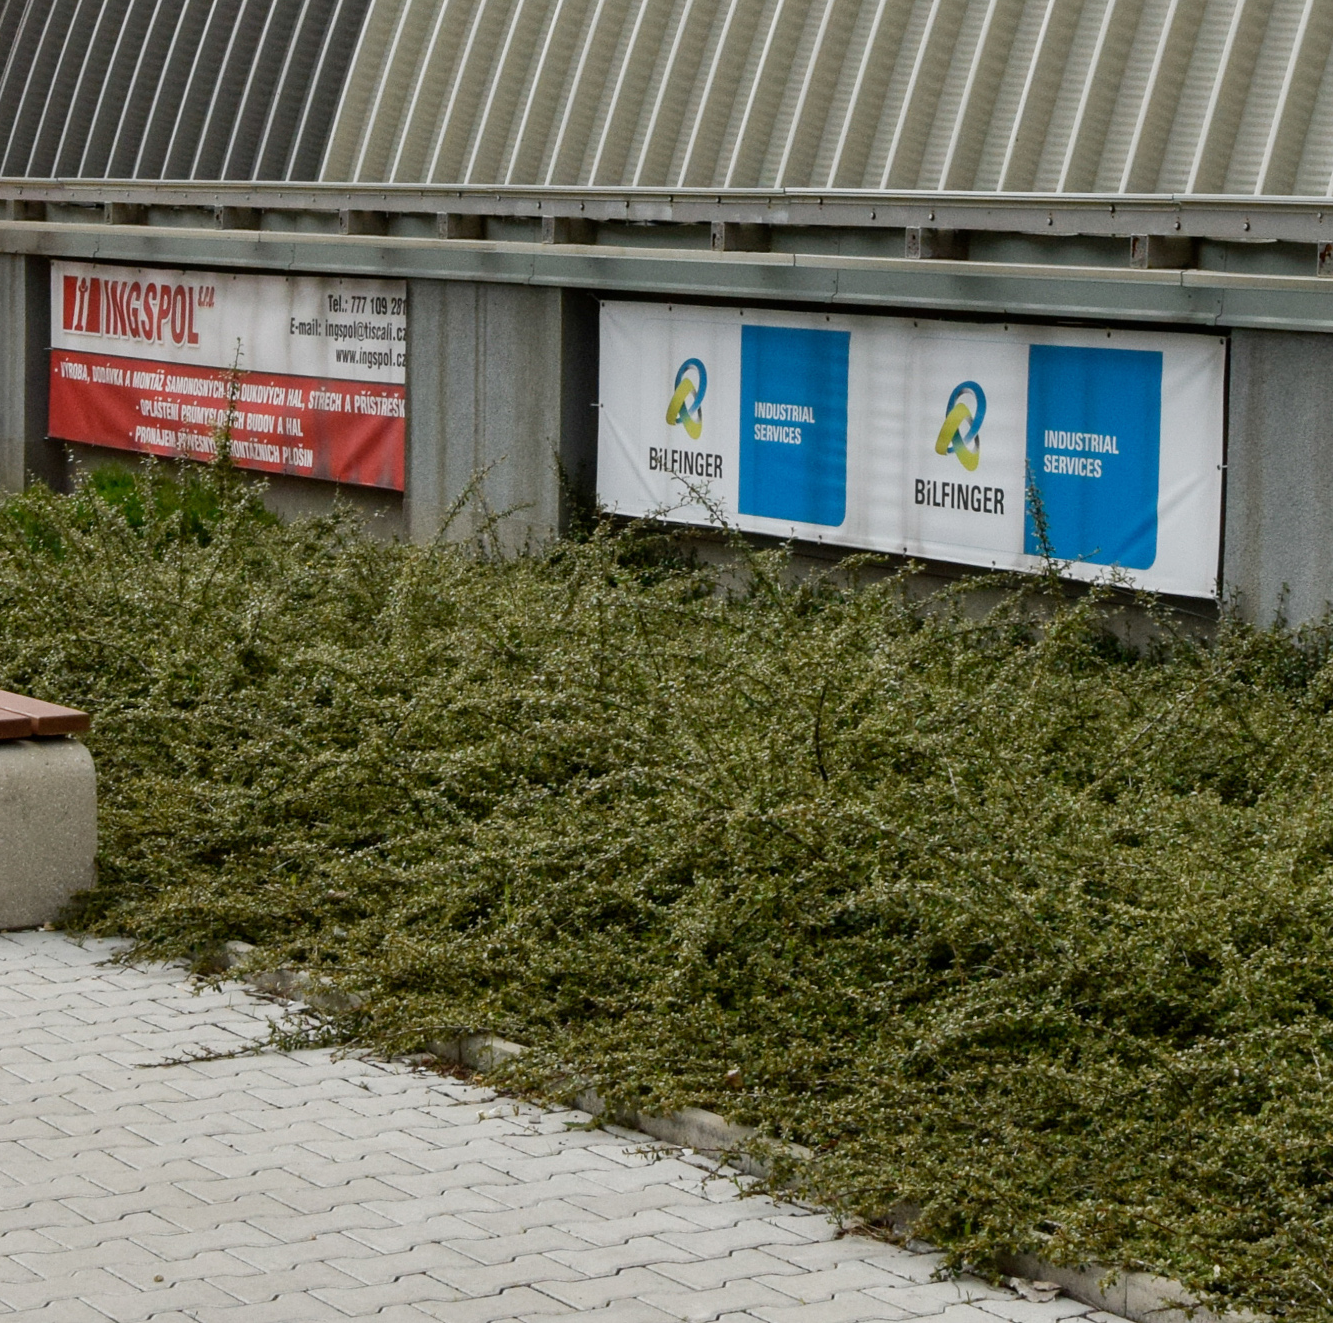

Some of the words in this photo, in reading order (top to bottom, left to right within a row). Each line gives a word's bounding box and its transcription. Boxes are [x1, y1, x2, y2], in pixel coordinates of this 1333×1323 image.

[104, 280, 198, 344] INGSPOL
[328, 294, 348, 313] Tel.:
[351, 296, 367, 314] 777
[370, 297, 387, 315] 109
[391, 298, 406, 315] 281
[290, 317, 321, 336] E-mail:
[325, 319, 406, 342] ingspol@tiscali.cz
[336, 347, 406, 369] www.ingspol.cz
[60, 358, 90, 384] VÝROBA,
[92, 363, 123, 386] DODÁVKA
[125, 370, 131, 387] A
[133, 369, 163, 391] MONTÁŽ
[165, 375, 224, 398] SAMONOSNÝCH
[286, 388, 304, 411] HAL,
[308, 387, 341, 412] STŘECH
[345, 394, 351, 412] A
[140, 396, 179, 421] OPLÁŠTĚNÍ
[247, 412, 274, 433] BUDOV
[277, 417, 283, 435] A
[286, 417, 303, 437] HAL
[754, 401, 816, 424] INDUSTRIAL
[135, 424, 175, 448] PRONÁJEM
[282, 442, 313, 468] PLOŠIN
[754, 424, 802, 445] SERVICES
[1044, 430, 1119, 454] INDUSTRIAL
[1043, 454, 1102, 478] SERVICES
